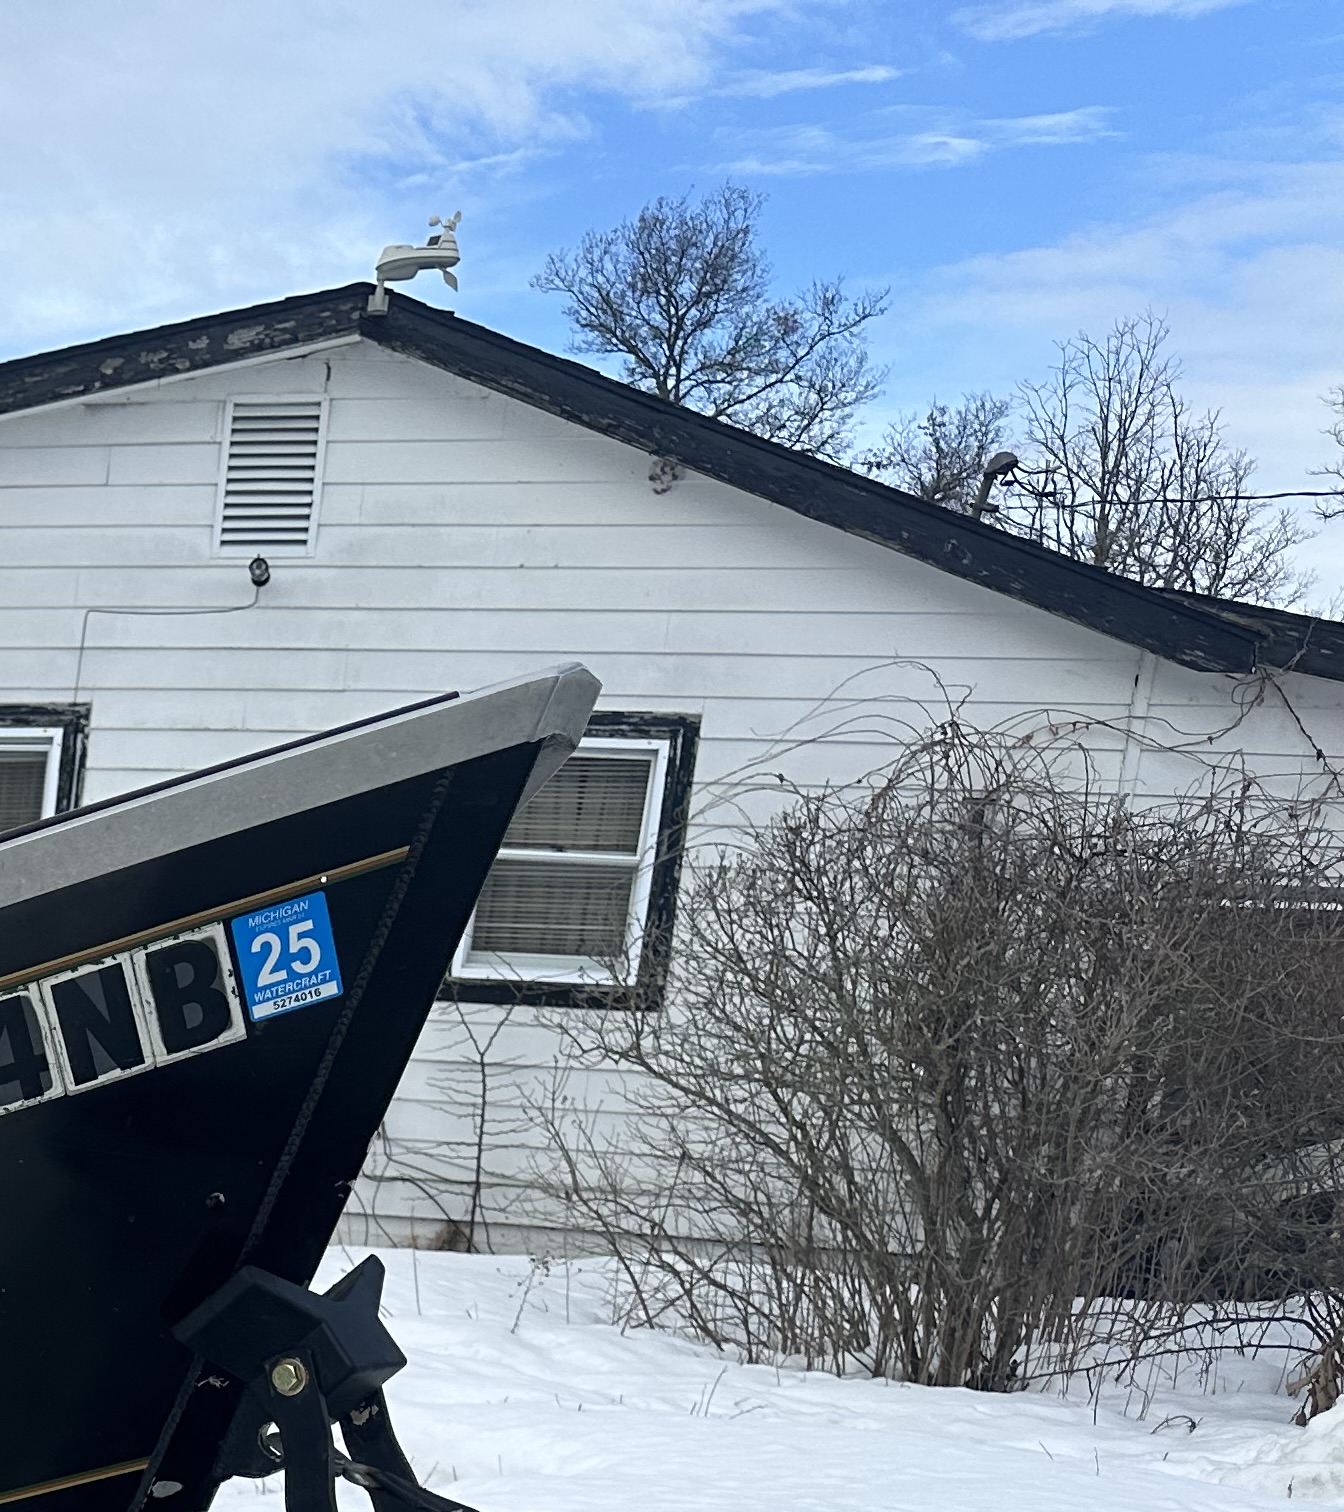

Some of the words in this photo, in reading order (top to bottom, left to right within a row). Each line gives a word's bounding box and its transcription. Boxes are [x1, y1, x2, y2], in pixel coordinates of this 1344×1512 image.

[248, 900, 309, 928] MICHIGAN
[250, 919, 321, 988] 25
[254, 970, 332, 1003] WATERCRAFT
[272, 987, 322, 1011] 5274016
